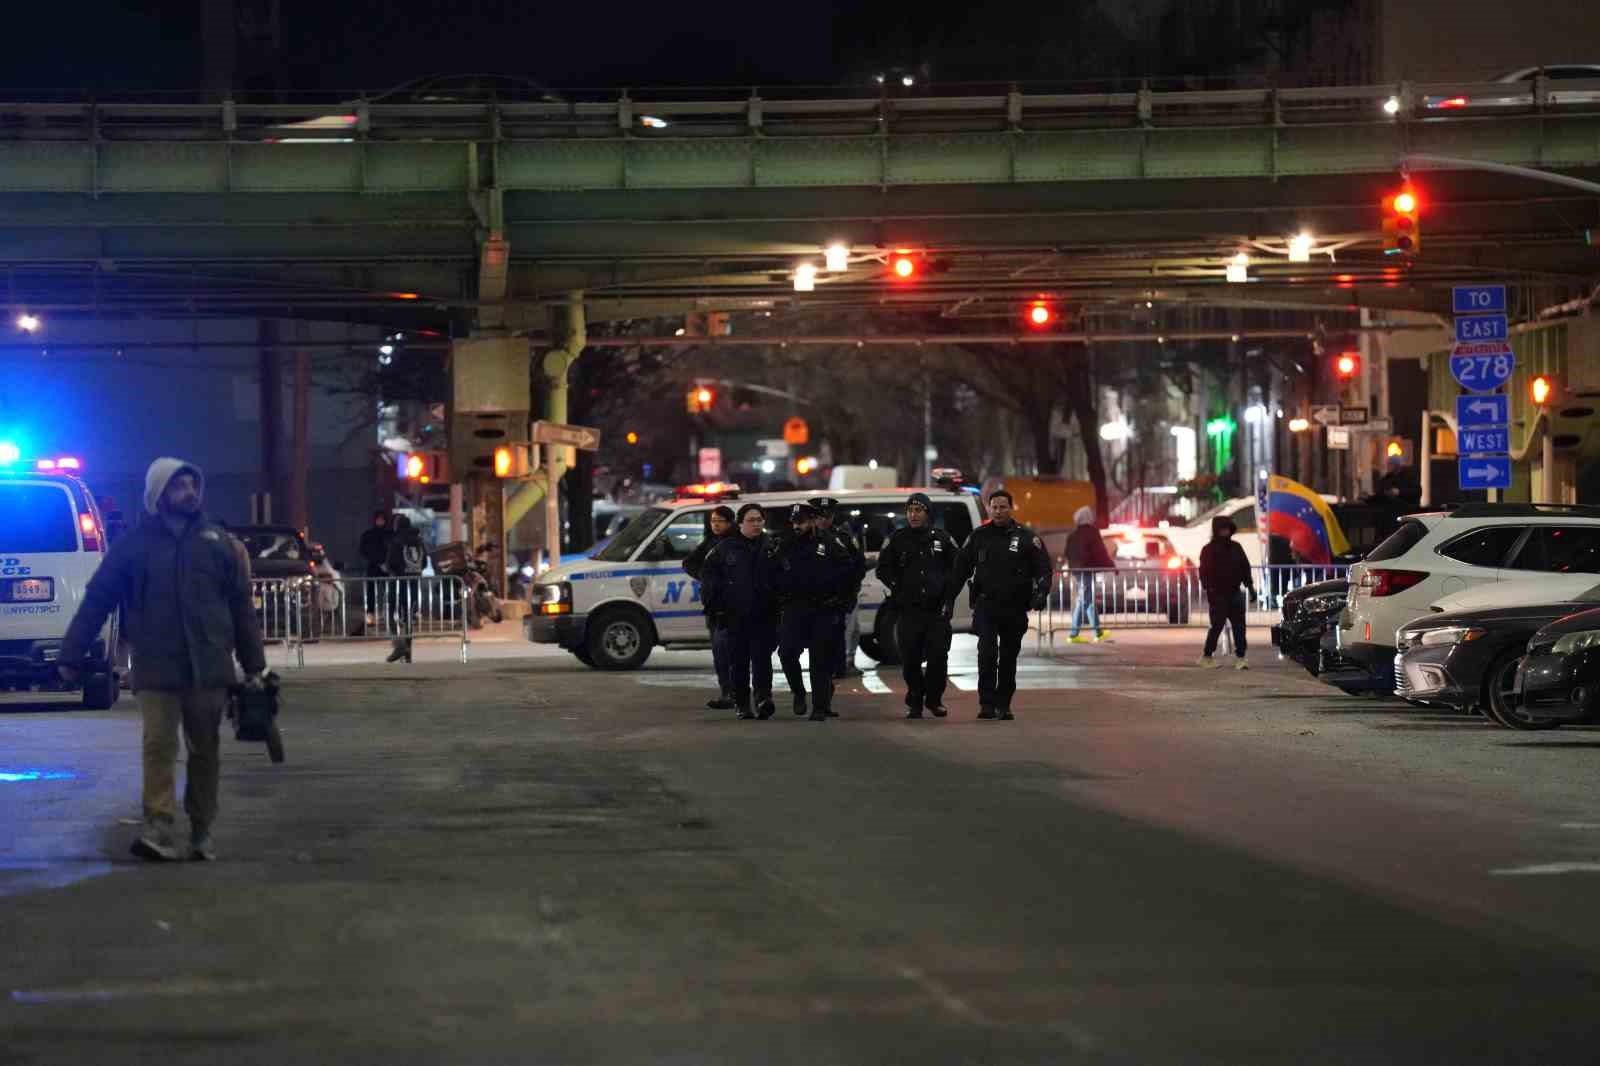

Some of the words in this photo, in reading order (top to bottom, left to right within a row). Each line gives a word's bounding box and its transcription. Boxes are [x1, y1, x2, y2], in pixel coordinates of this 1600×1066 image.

[1468, 291, 1491, 306] TO
[1461, 320, 1499, 337] EAST
[1459, 356, 1509, 380] 278
[1464, 432, 1503, 450] WEST
[0, 566, 31, 575] CE
